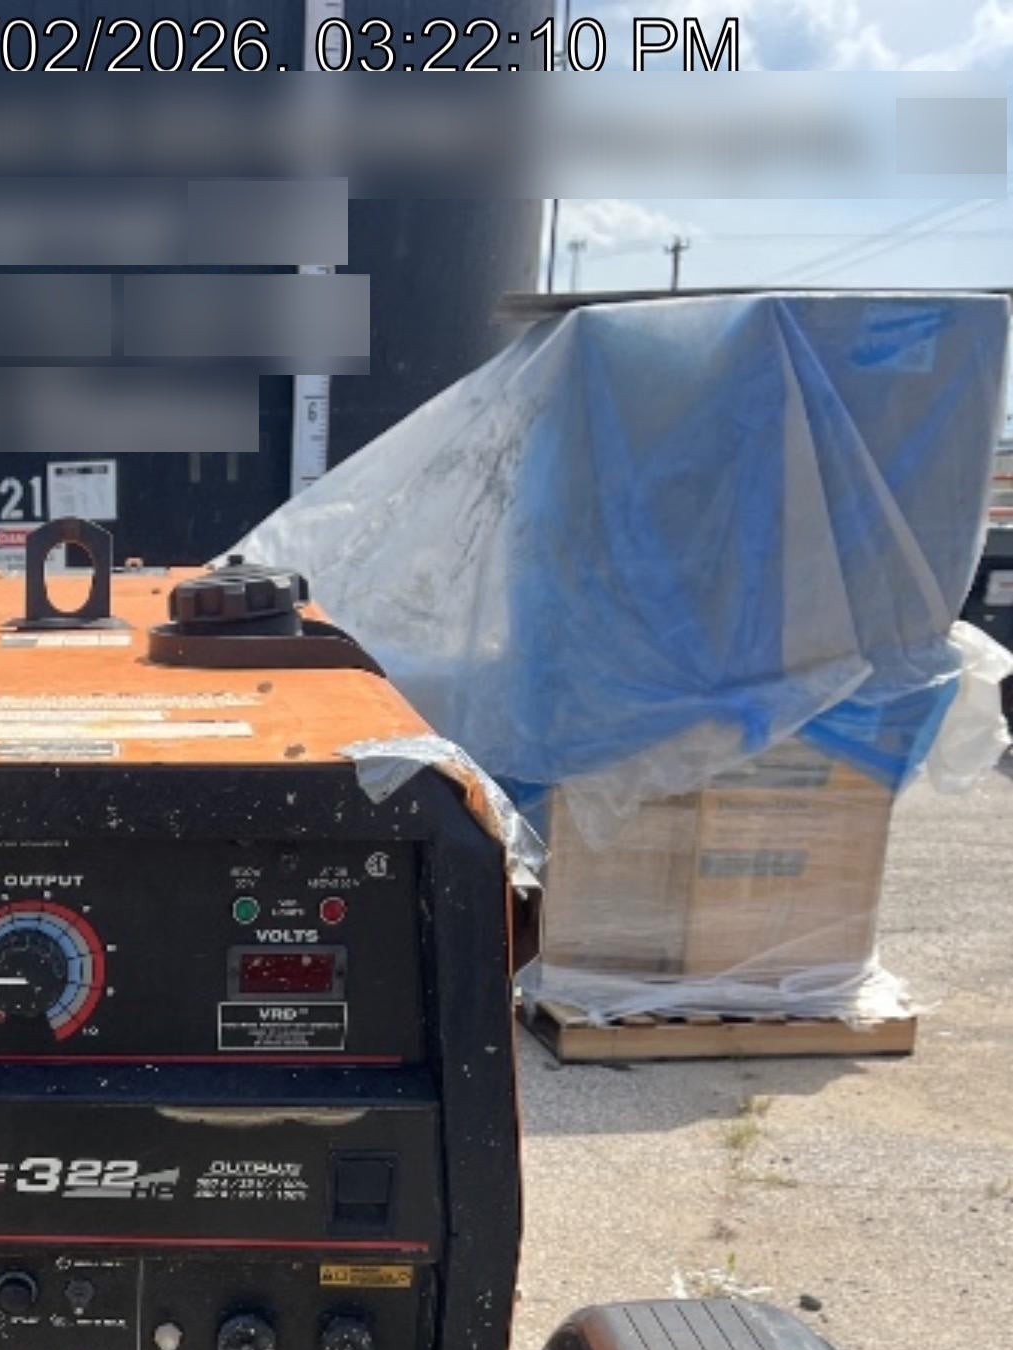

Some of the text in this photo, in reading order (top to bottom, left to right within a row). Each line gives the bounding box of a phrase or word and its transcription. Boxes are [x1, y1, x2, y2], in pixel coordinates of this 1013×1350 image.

[4, 875, 84, 887] OUTPUT
[256, 929, 318, 943] VOLTS
[16, 1157, 138, 1192] 322
